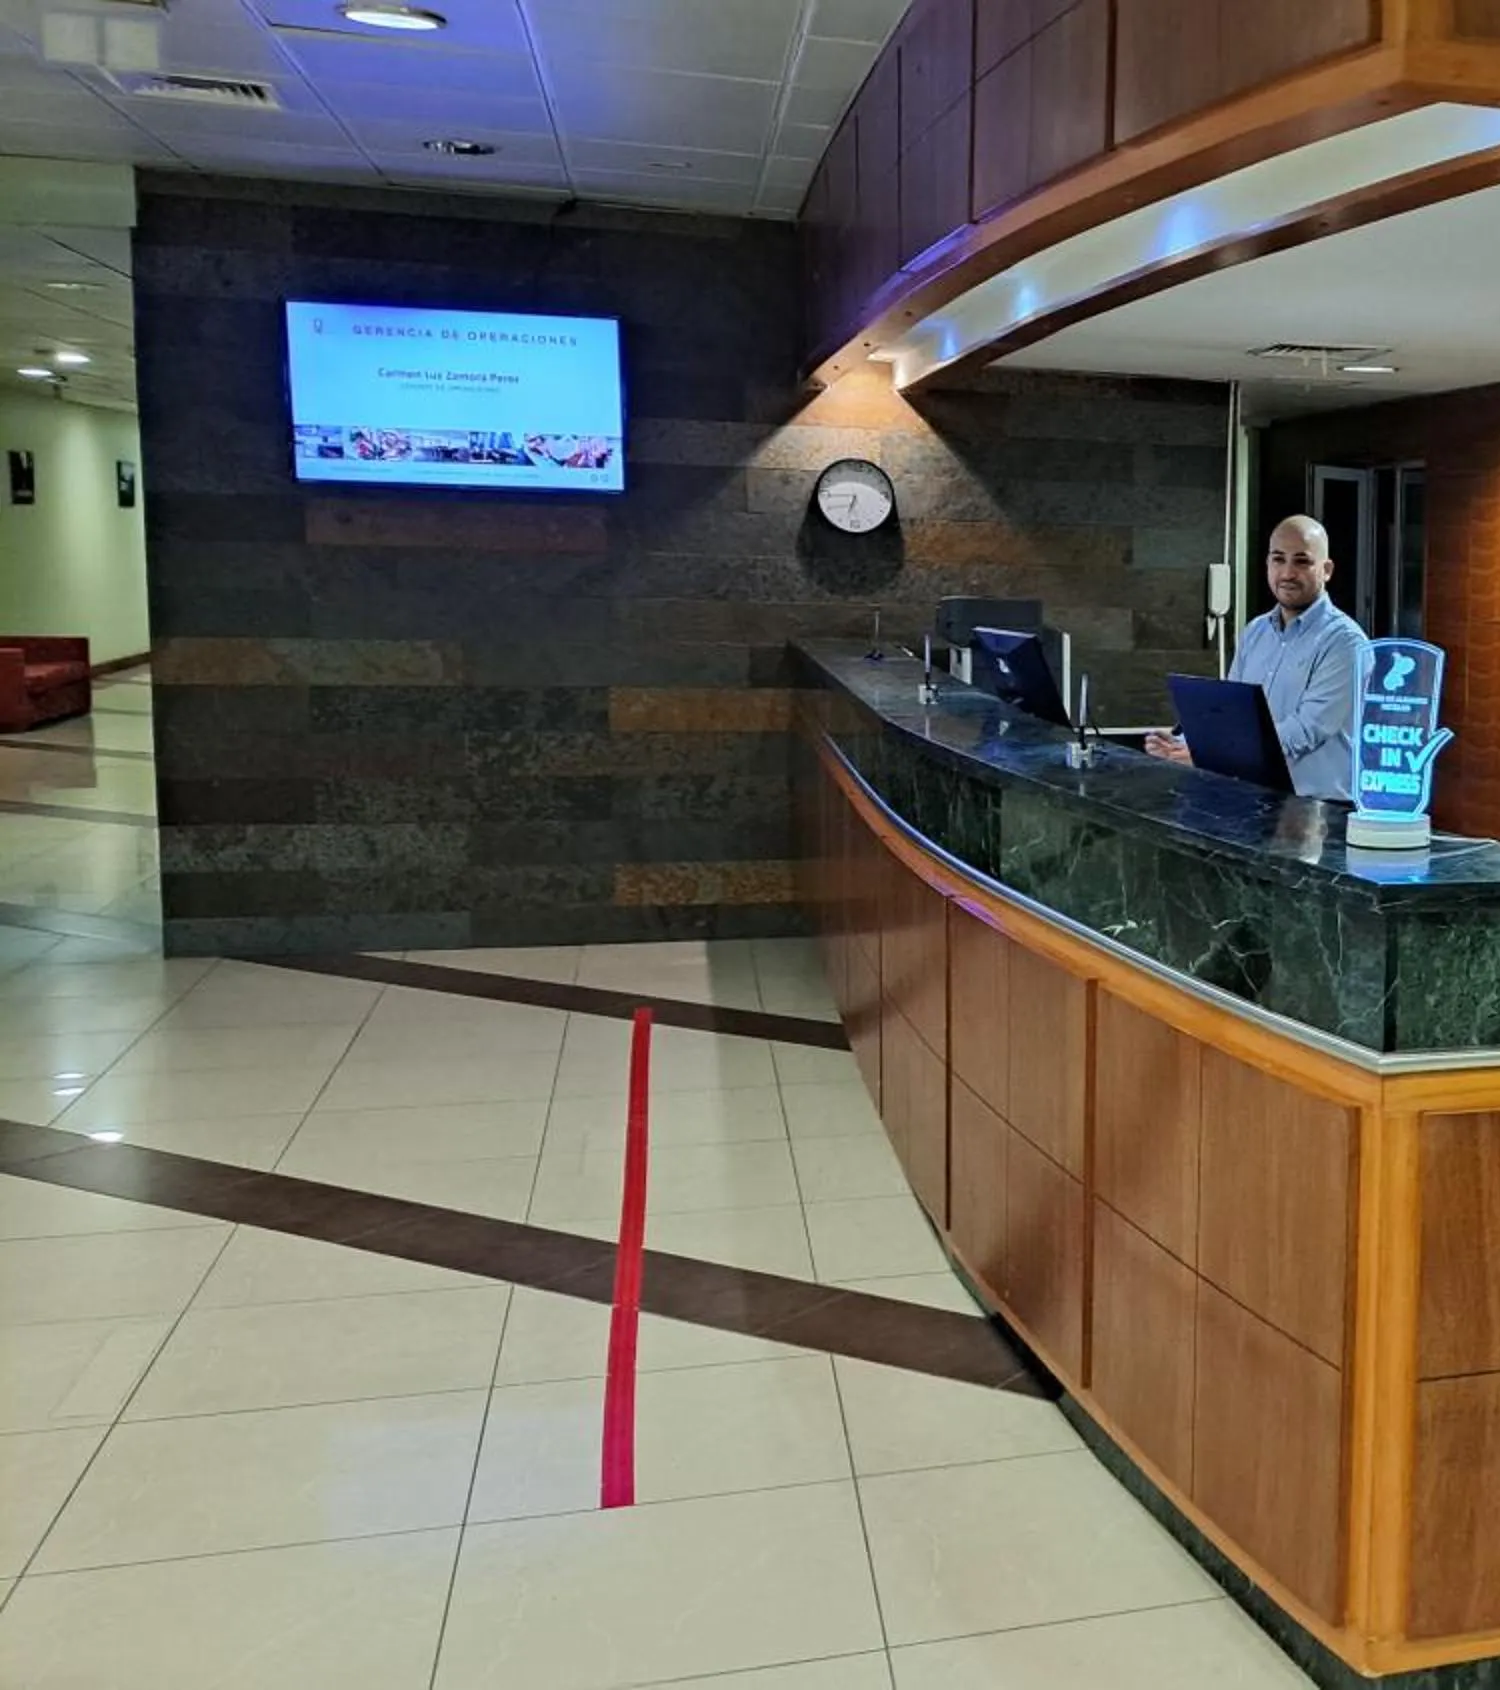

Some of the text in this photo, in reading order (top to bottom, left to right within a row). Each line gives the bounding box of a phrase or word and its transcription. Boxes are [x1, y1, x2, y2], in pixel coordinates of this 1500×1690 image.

[352, 323, 577, 346] GERENCIA DE OPERACIONES
[1363, 723, 1424, 747] CHECK
[1380, 747, 1402, 768] IN
[1361, 768, 1422, 795] EXPRESS
